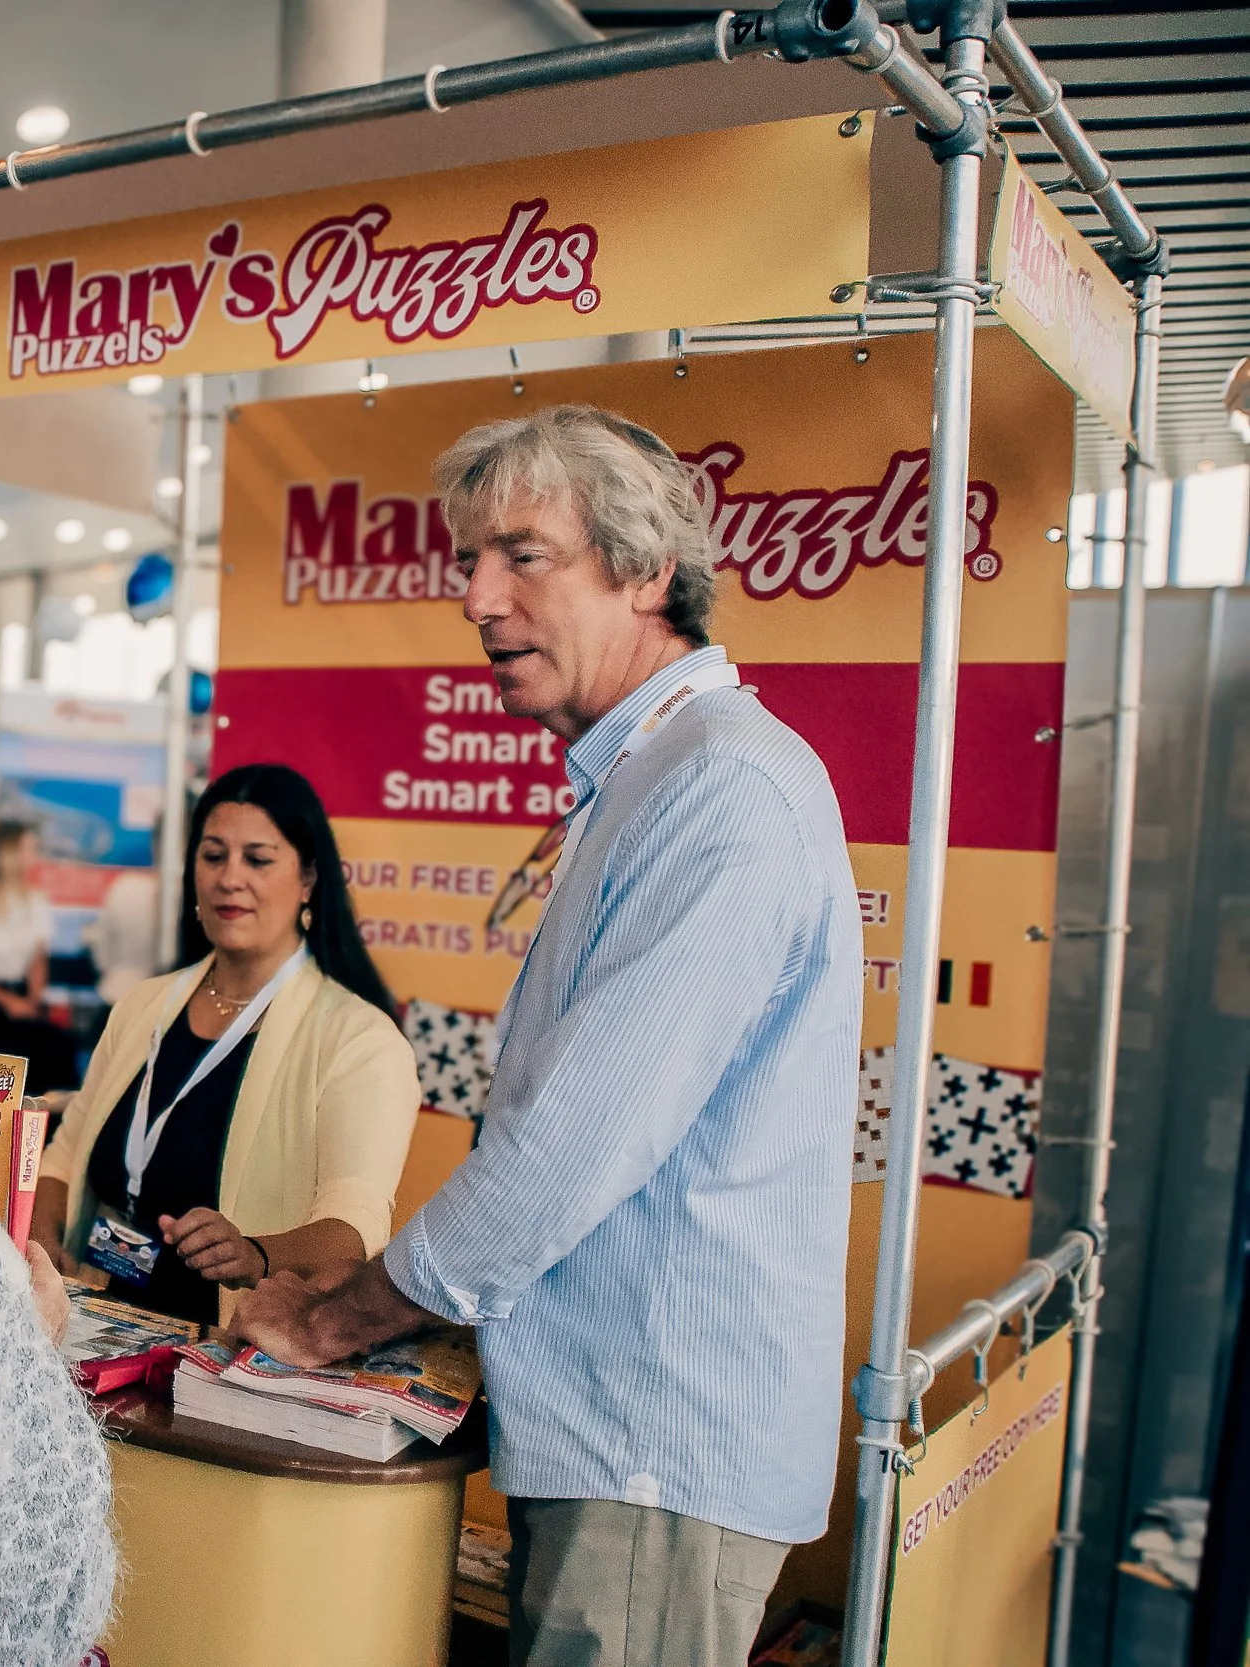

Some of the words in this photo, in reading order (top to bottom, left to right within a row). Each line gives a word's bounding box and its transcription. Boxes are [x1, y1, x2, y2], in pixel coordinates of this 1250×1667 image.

[8, 220, 278, 348] Mary's
[10, 318, 166, 379] Puzzels
[422, 723, 557, 765] Smart
[382, 769, 514, 814] Smart
[410, 865, 496, 896] FREE
[358, 917, 473, 954] GRATIS
[902, 1500, 933, 1556] GET
[935, 1466, 972, 1526] YOUR
